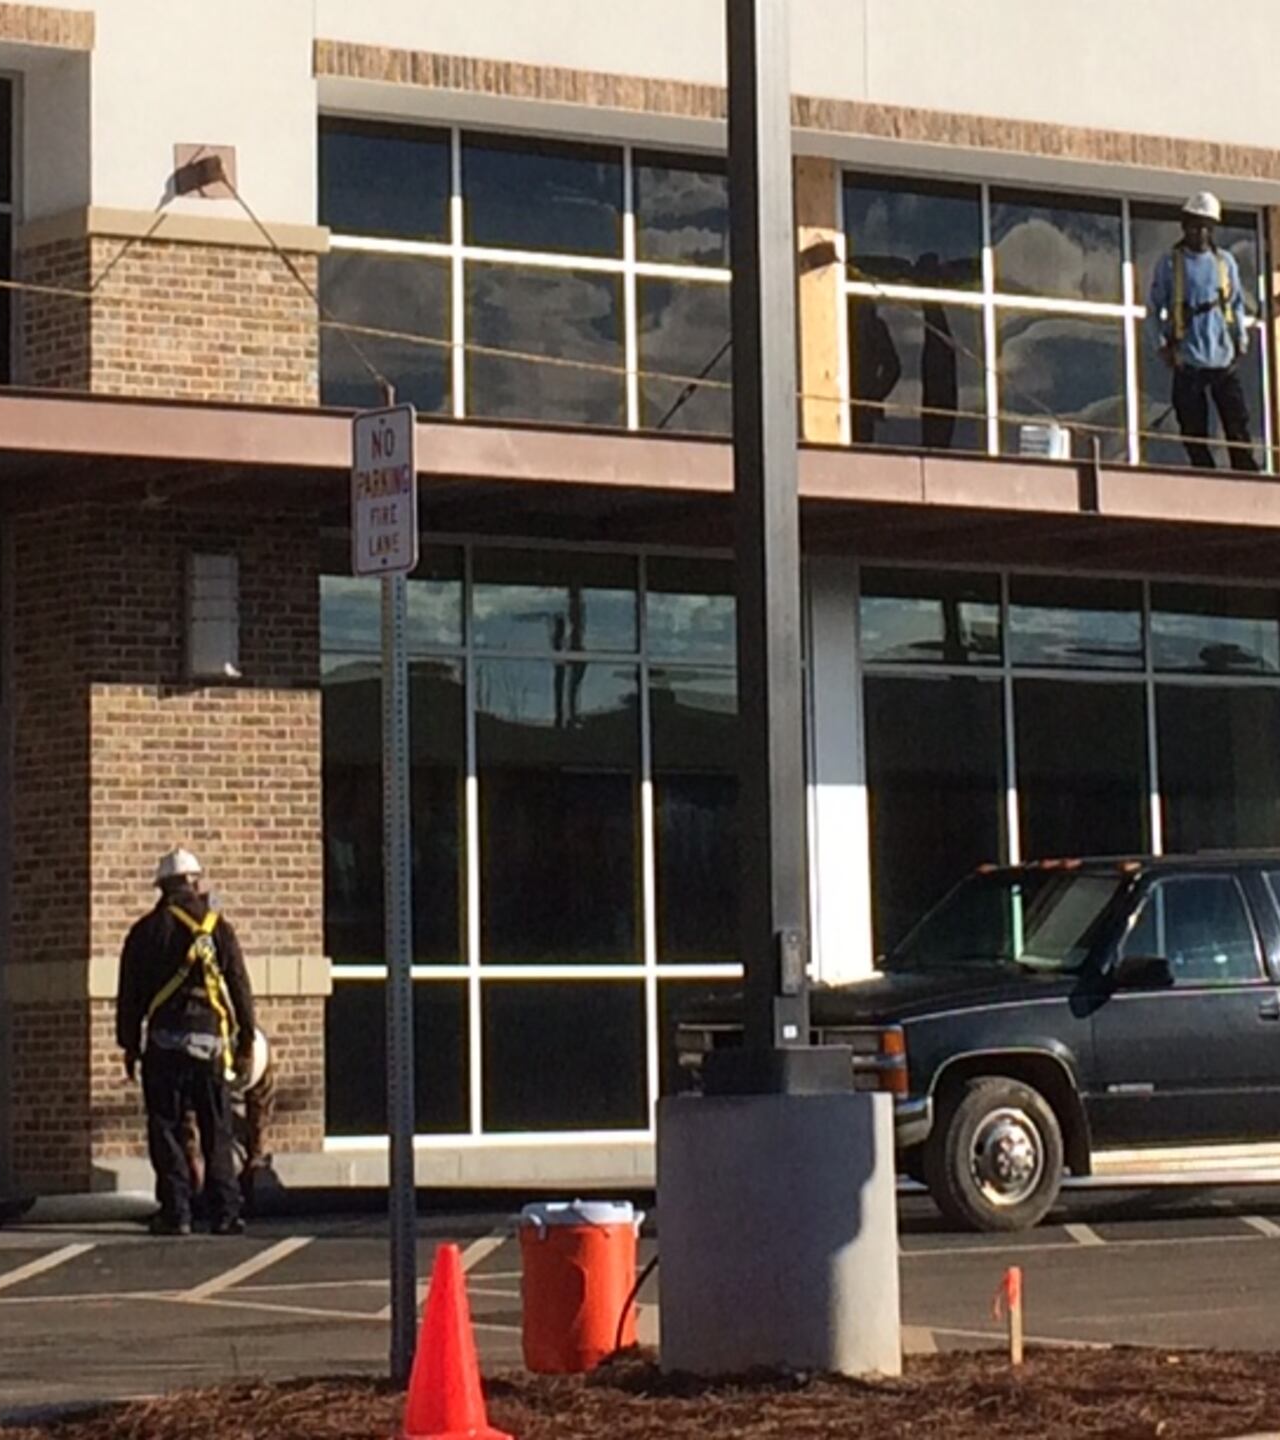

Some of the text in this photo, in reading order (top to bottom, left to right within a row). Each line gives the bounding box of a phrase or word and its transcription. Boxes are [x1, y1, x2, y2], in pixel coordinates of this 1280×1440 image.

[371, 428, 396, 459] NO
[370, 503, 398, 529] FIRE
[369, 532, 400, 557] LANE
